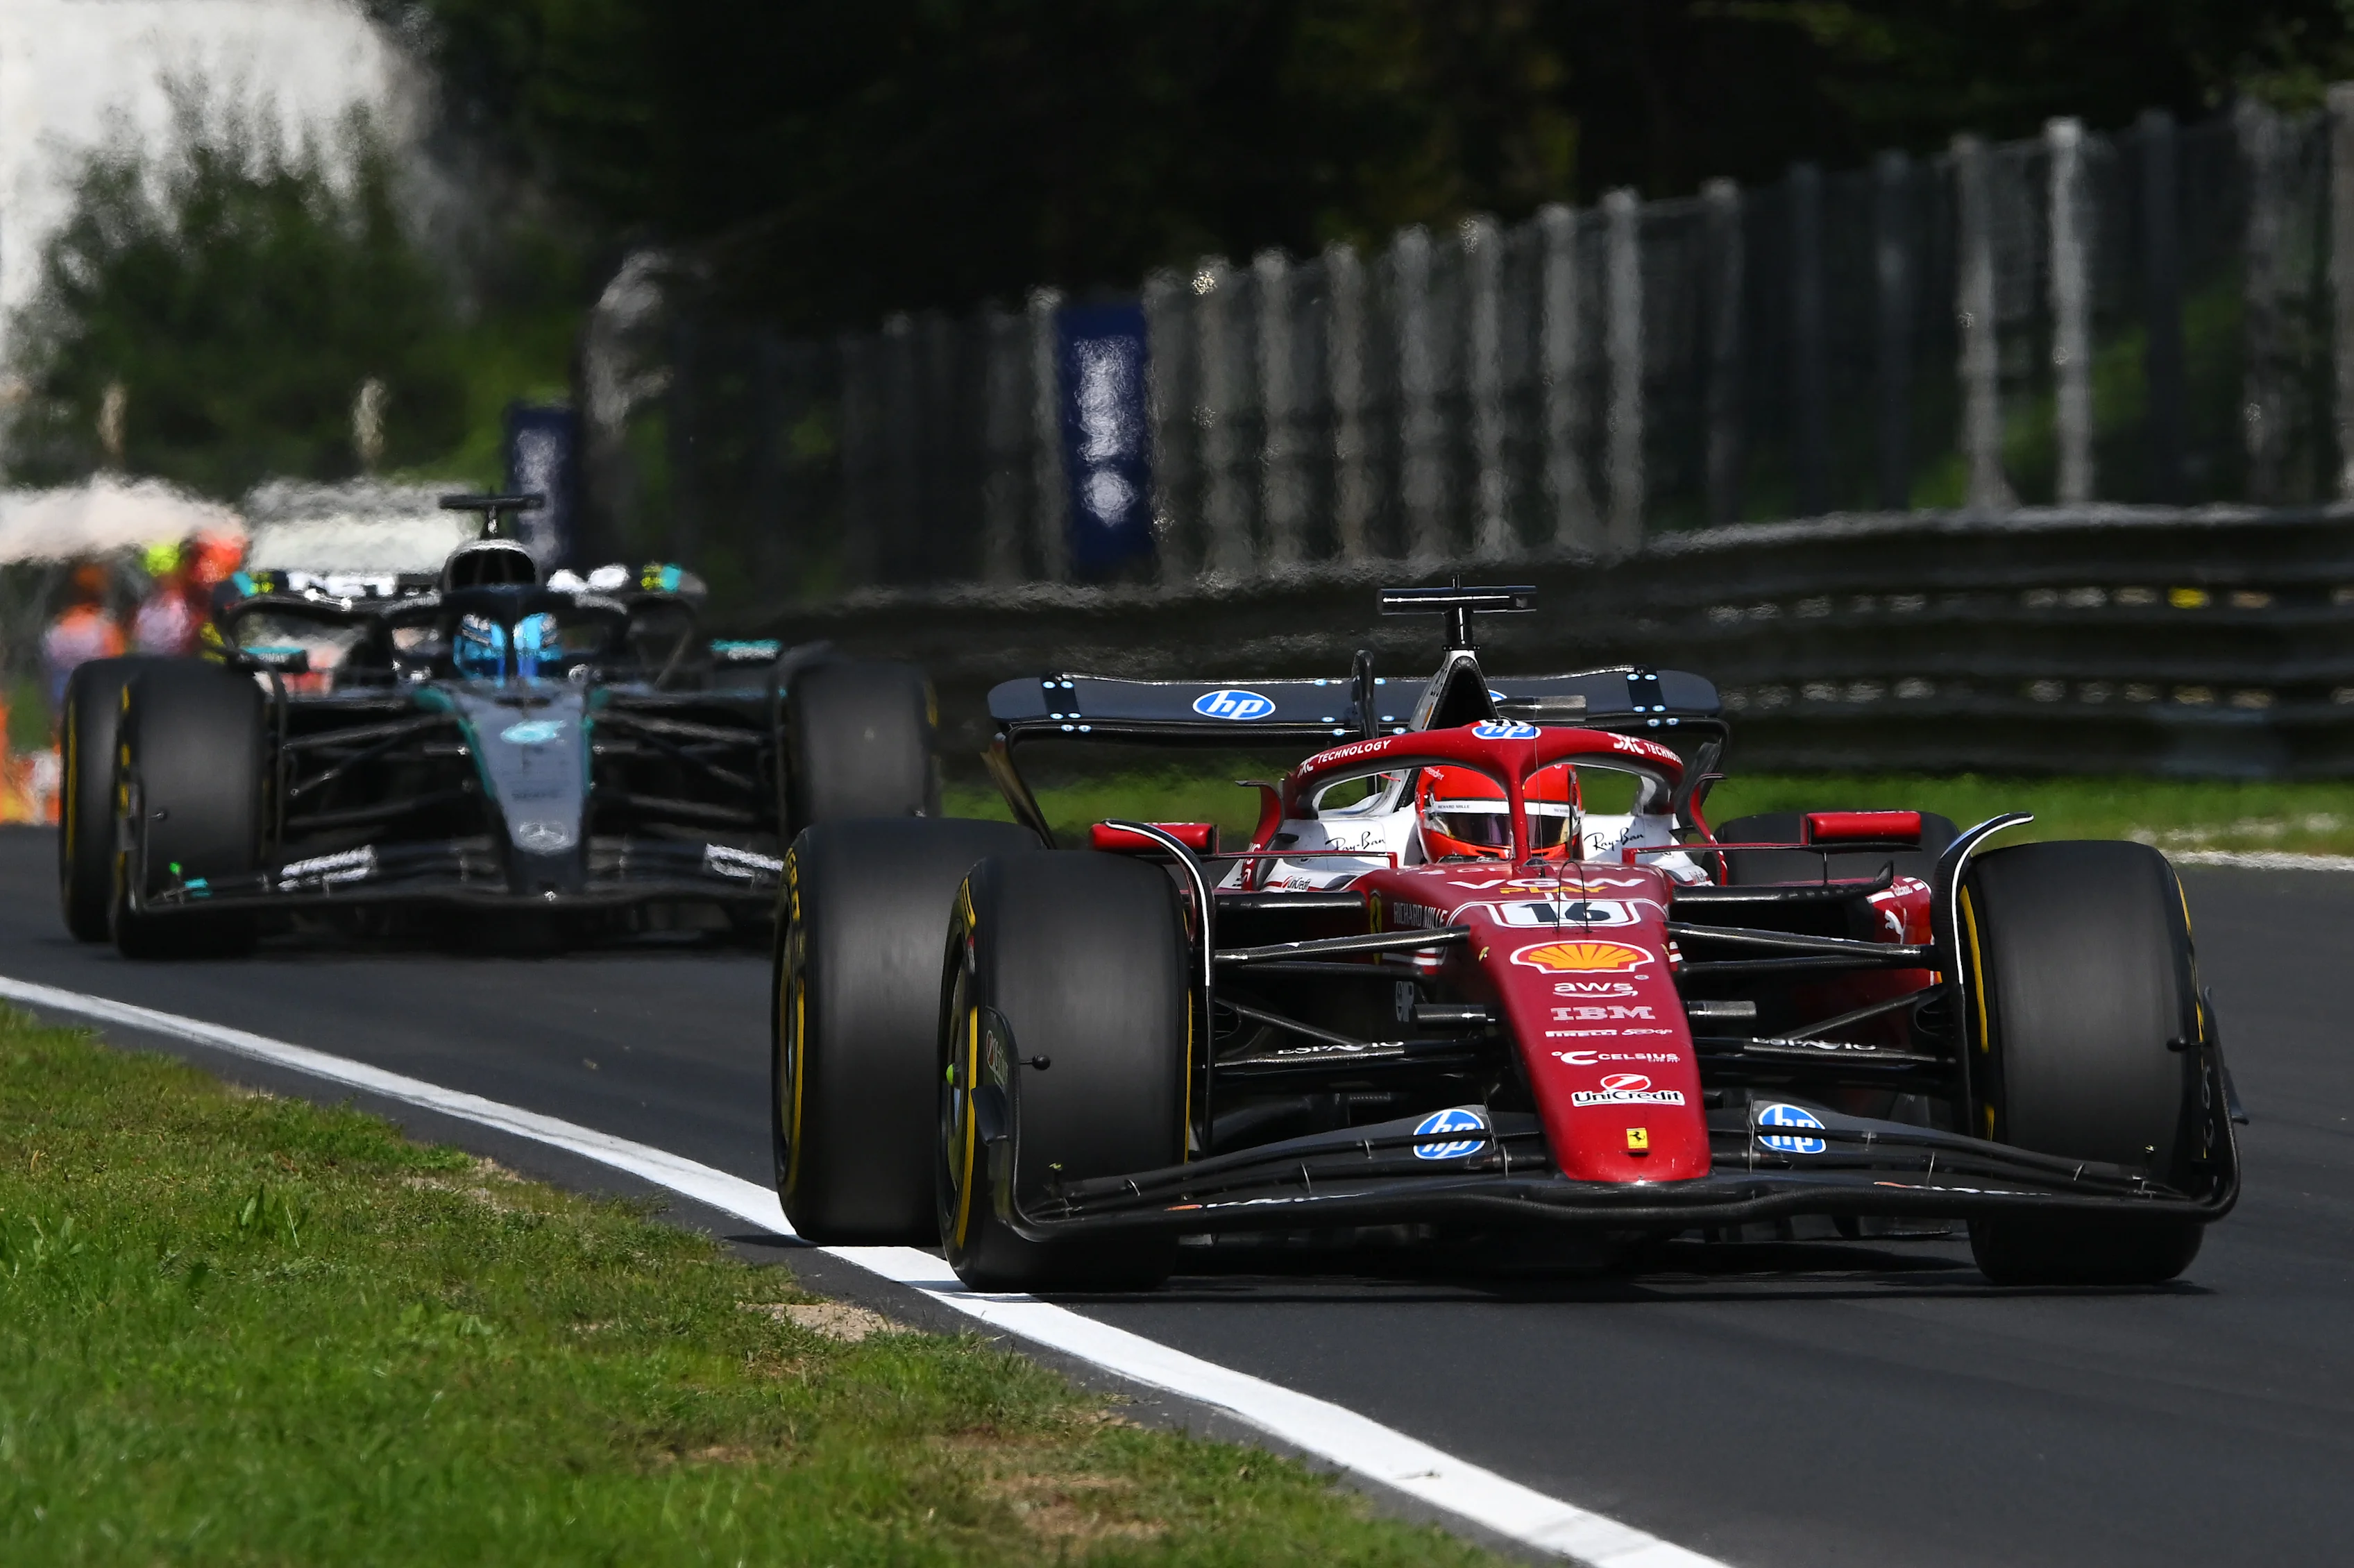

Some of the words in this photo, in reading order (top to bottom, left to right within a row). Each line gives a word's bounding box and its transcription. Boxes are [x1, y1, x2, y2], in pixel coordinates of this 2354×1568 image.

[1205, 691, 1265, 719] hp
[1318, 740, 1391, 764] TECHNOLOGY
[1325, 831, 1386, 851] Ray-Ban
[1584, 827, 1644, 852] Ray-Ban
[1446, 878, 1646, 889] VGW
[1499, 886, 1608, 894] PLAY
[1394, 902, 1423, 927] RICHARD
[1423, 905, 1449, 930] MILLE
[1518, 902, 1611, 923] 16
[1554, 982, 1634, 992] aws
[1550, 1006, 1656, 1021] IBM
[1545, 1029, 1618, 1038] PIRELLI
[1598, 1053, 1679, 1061] CELSIUS
[1574, 1091, 1682, 1102] UniCredit
[1421, 1109, 1477, 1158] hp
[1771, 1105, 1816, 1152] hp
